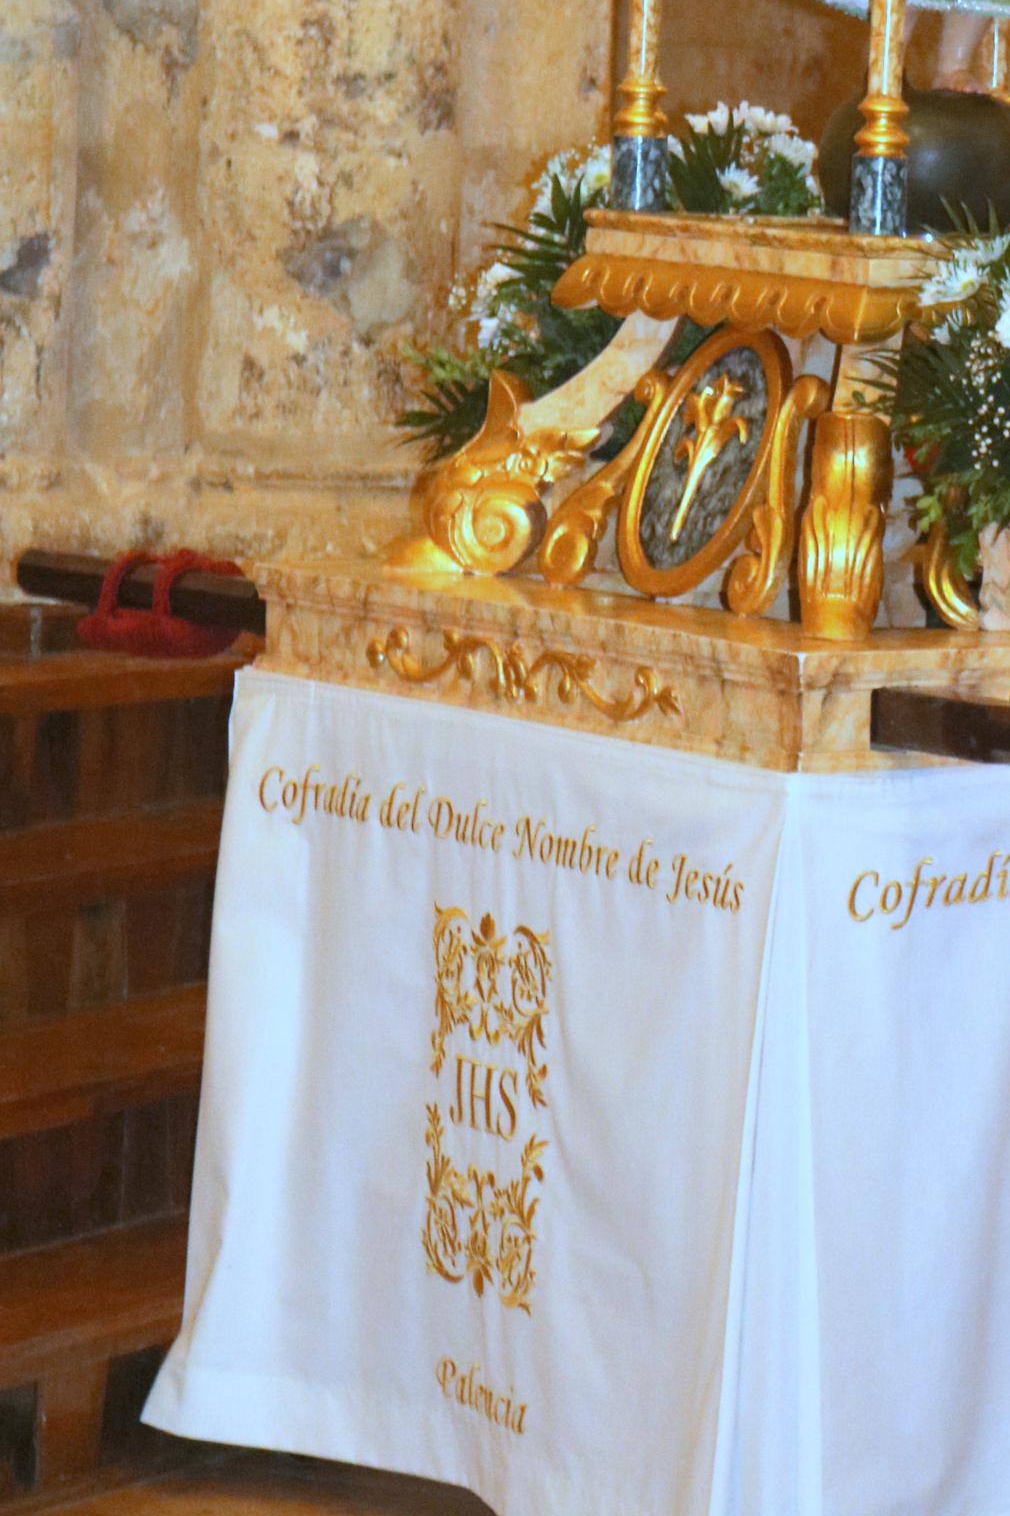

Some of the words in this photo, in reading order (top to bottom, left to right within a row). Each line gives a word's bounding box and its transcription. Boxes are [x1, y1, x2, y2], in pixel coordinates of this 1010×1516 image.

[379, 782, 427, 833] del
[427, 795, 505, 852] Dulce
[512, 815, 619, 880] Nombre
[628, 837, 660, 889] de
[666, 853, 744, 912] Jesús
[449, 1053, 518, 1141] JHS
